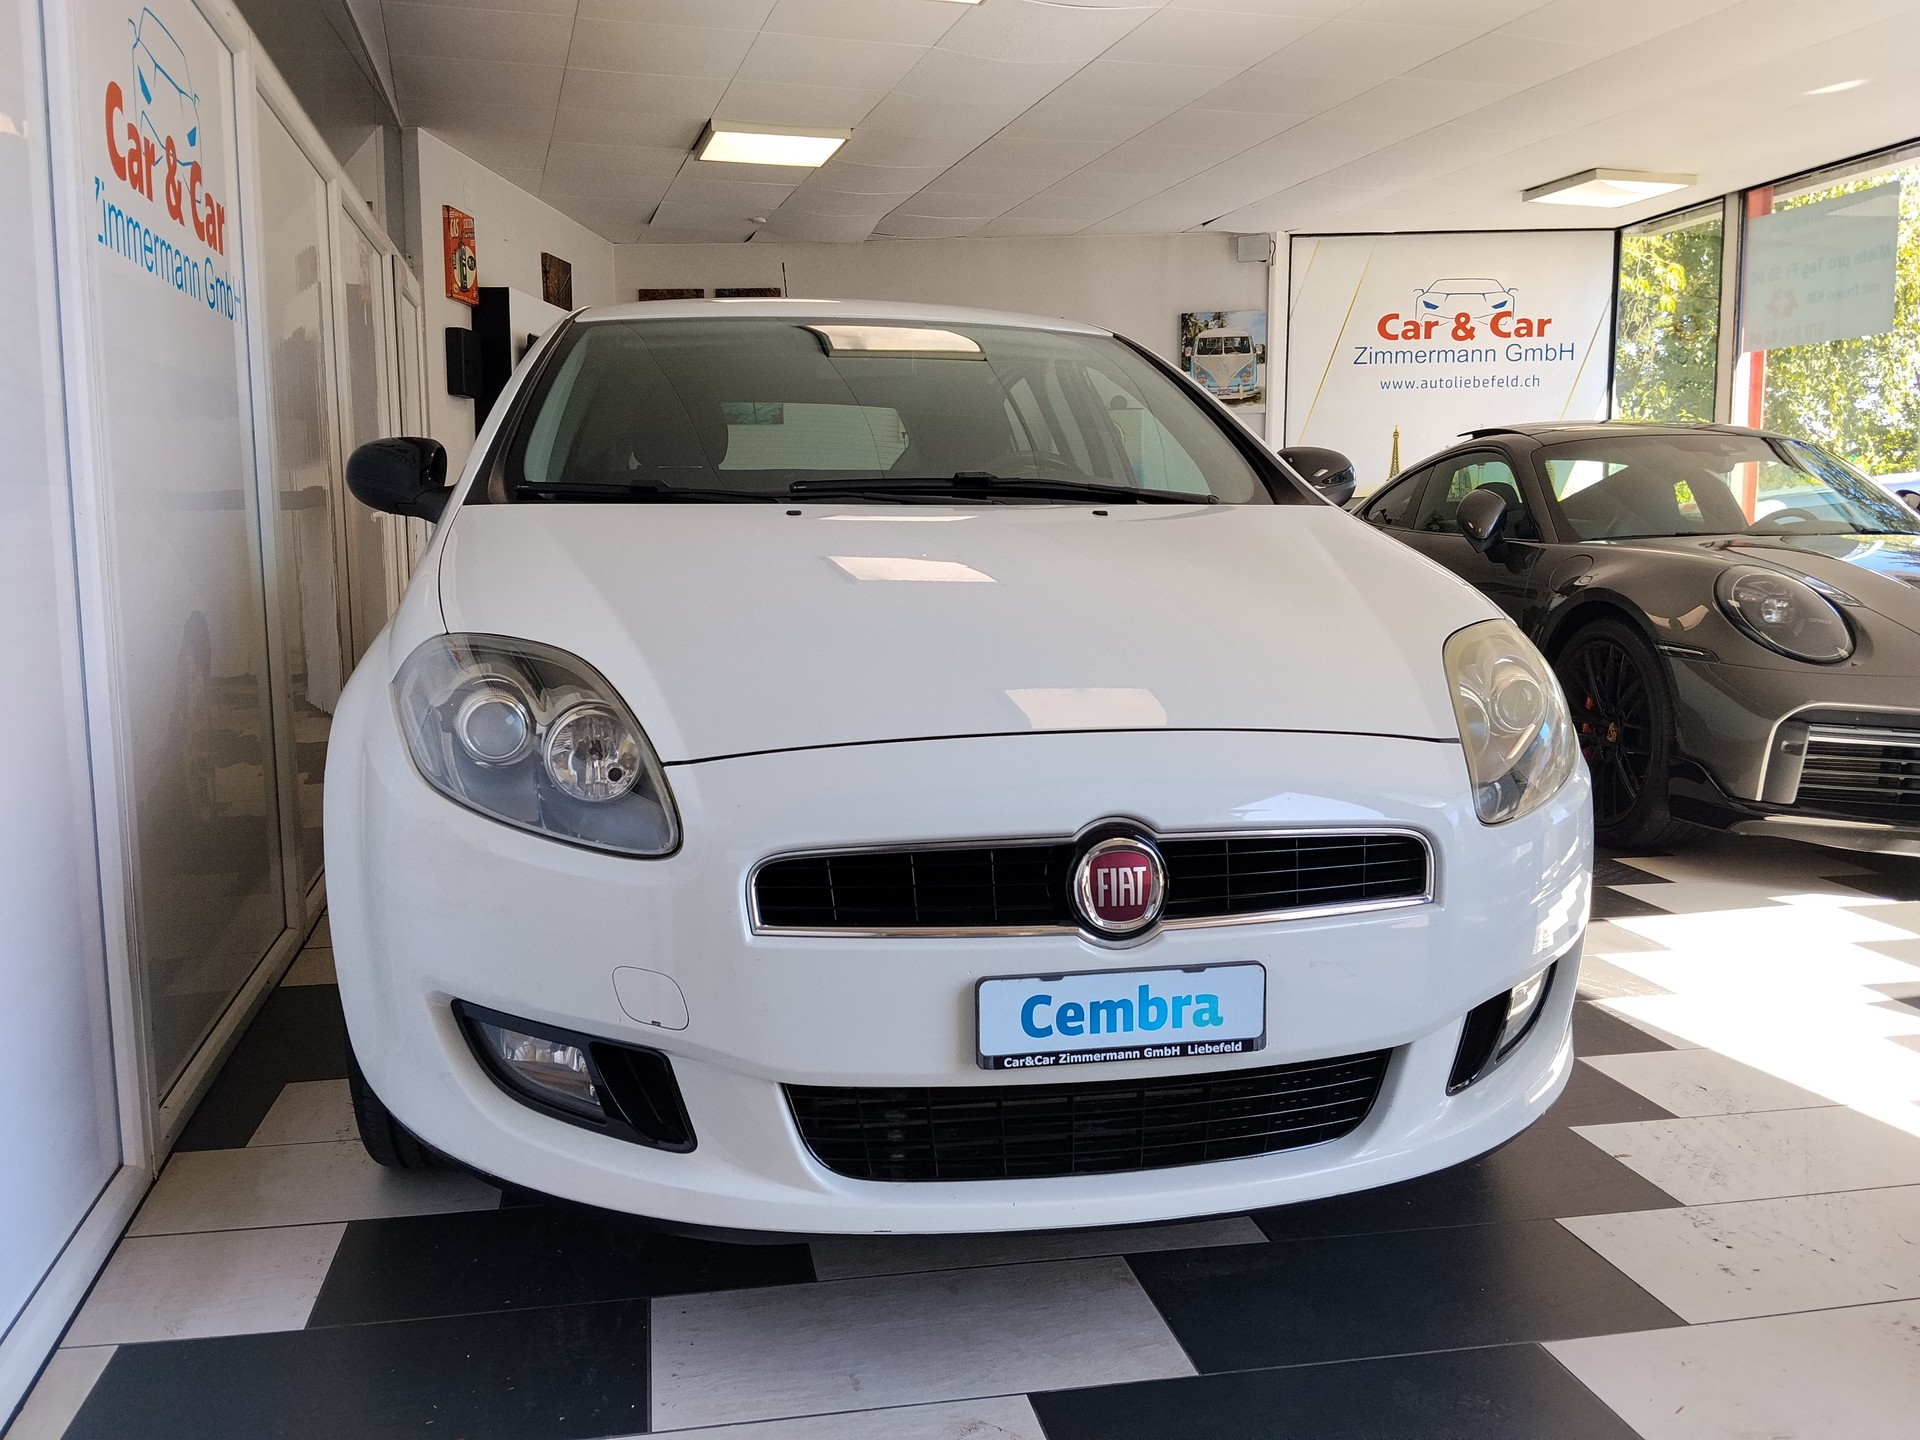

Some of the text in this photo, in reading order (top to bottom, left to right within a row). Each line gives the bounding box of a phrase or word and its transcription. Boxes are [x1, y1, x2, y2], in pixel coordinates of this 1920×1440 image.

[105, 81, 225, 256] Car & Car
[204, 257, 243, 326] GmbH
[1377, 311, 1552, 341] Car & Car
[1353, 343, 1575, 365] Zimmermann GmbH
[1380, 375, 1540, 390] www.autoliebefeld.ch
[1097, 866, 1147, 908] FIAT
[1020, 984, 1224, 1039] Cembra
[1003, 1041, 1243, 1068] Car&Car Zimmermann GmbH Liebefeld
